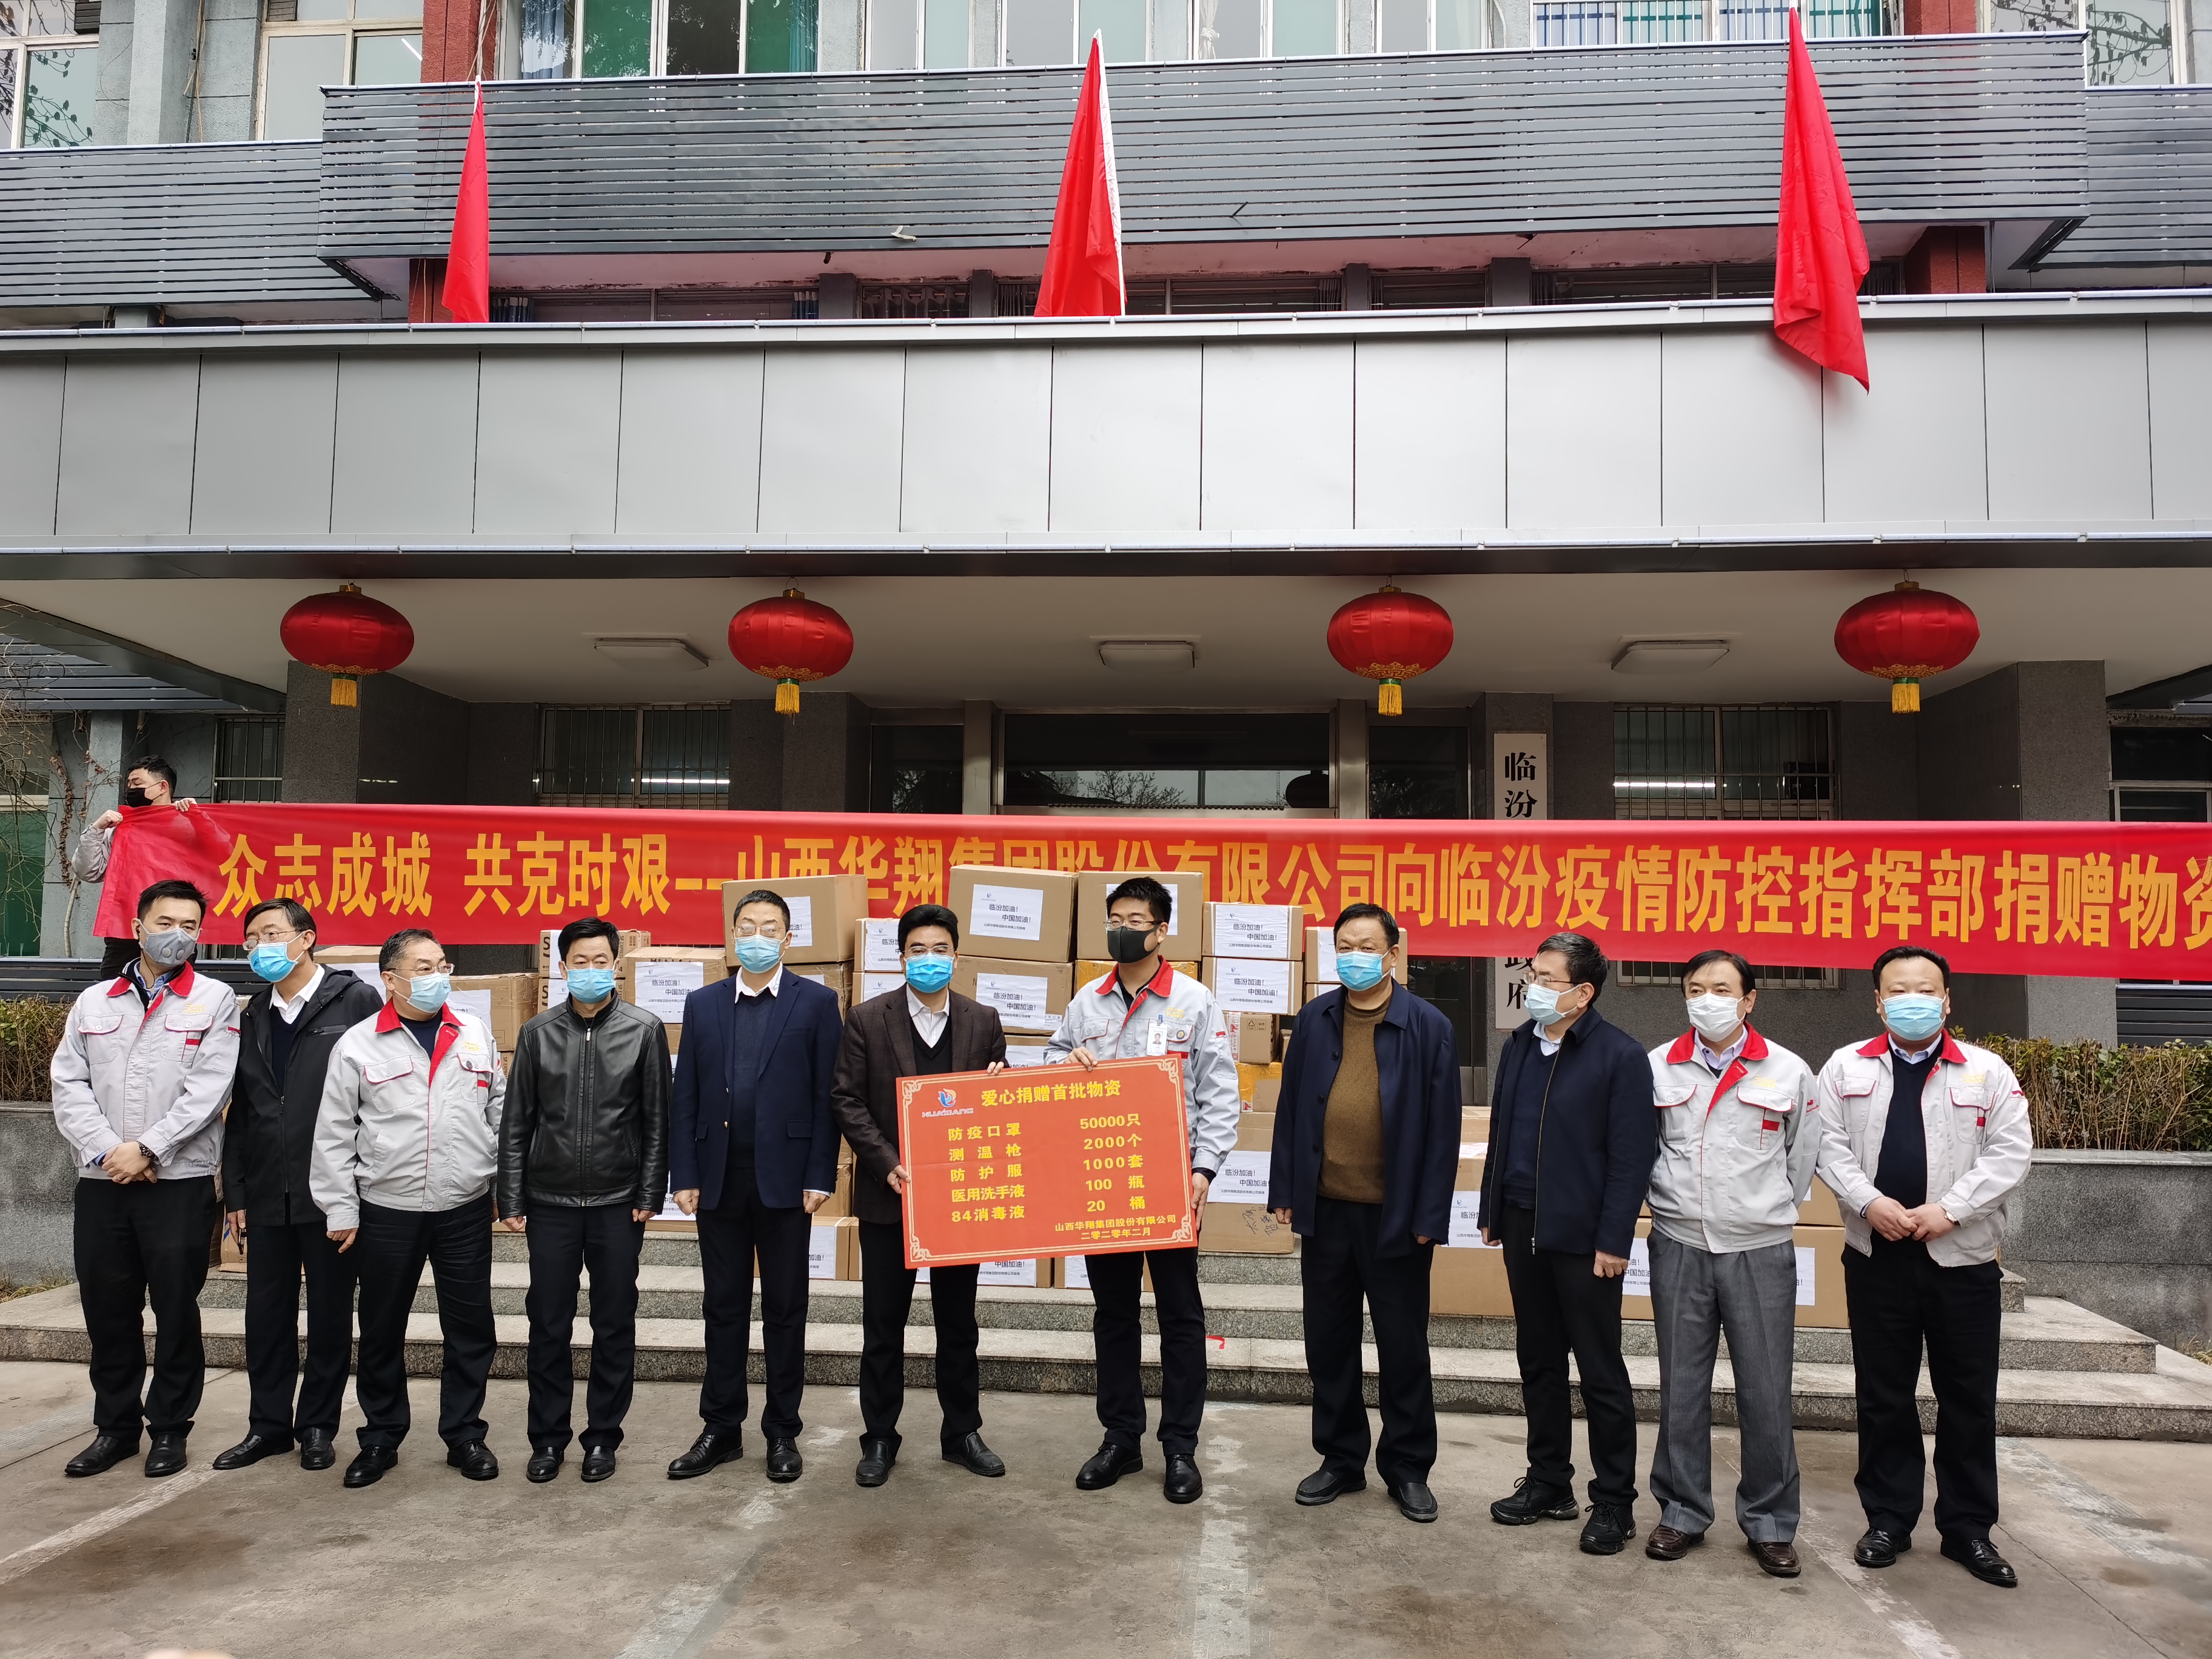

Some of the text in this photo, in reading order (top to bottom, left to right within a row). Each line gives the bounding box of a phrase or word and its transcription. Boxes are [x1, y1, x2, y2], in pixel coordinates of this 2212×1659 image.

[215, 832, 432, 918] 众志成城
[989, 903, 1019, 913] 临汾加油！
[1002, 914, 1031, 923] 中国加油！
[1233, 923, 1264, 931] 临汾加油！
[1233, 977, 1265, 987] 临汾加油！
[993, 991, 1024, 1000] 临汾加油！
[1247, 988, 1279, 997] 中国加油！
[1007, 1002, 1037, 1011] 中国加油！
[980, 1079, 1122, 1107] 爱心捐赠首批物资
[948, 1113, 1141, 1141] 防疫口罩 50000只
[948, 1133, 1142, 1161] 测温枪 2000个
[950, 1155, 1144, 1182] 防护服 1000套
[1224, 1168, 1256, 1177] 临汾加油！
[951, 1184, 1025, 1202] 医用洗手液
[951, 1205, 1025, 1222] 84消毒液
[1055, 1215, 1176, 1232] 山西华翔集团股份有限公司
[1081, 1227, 1151, 1240] 二零二零年二月
